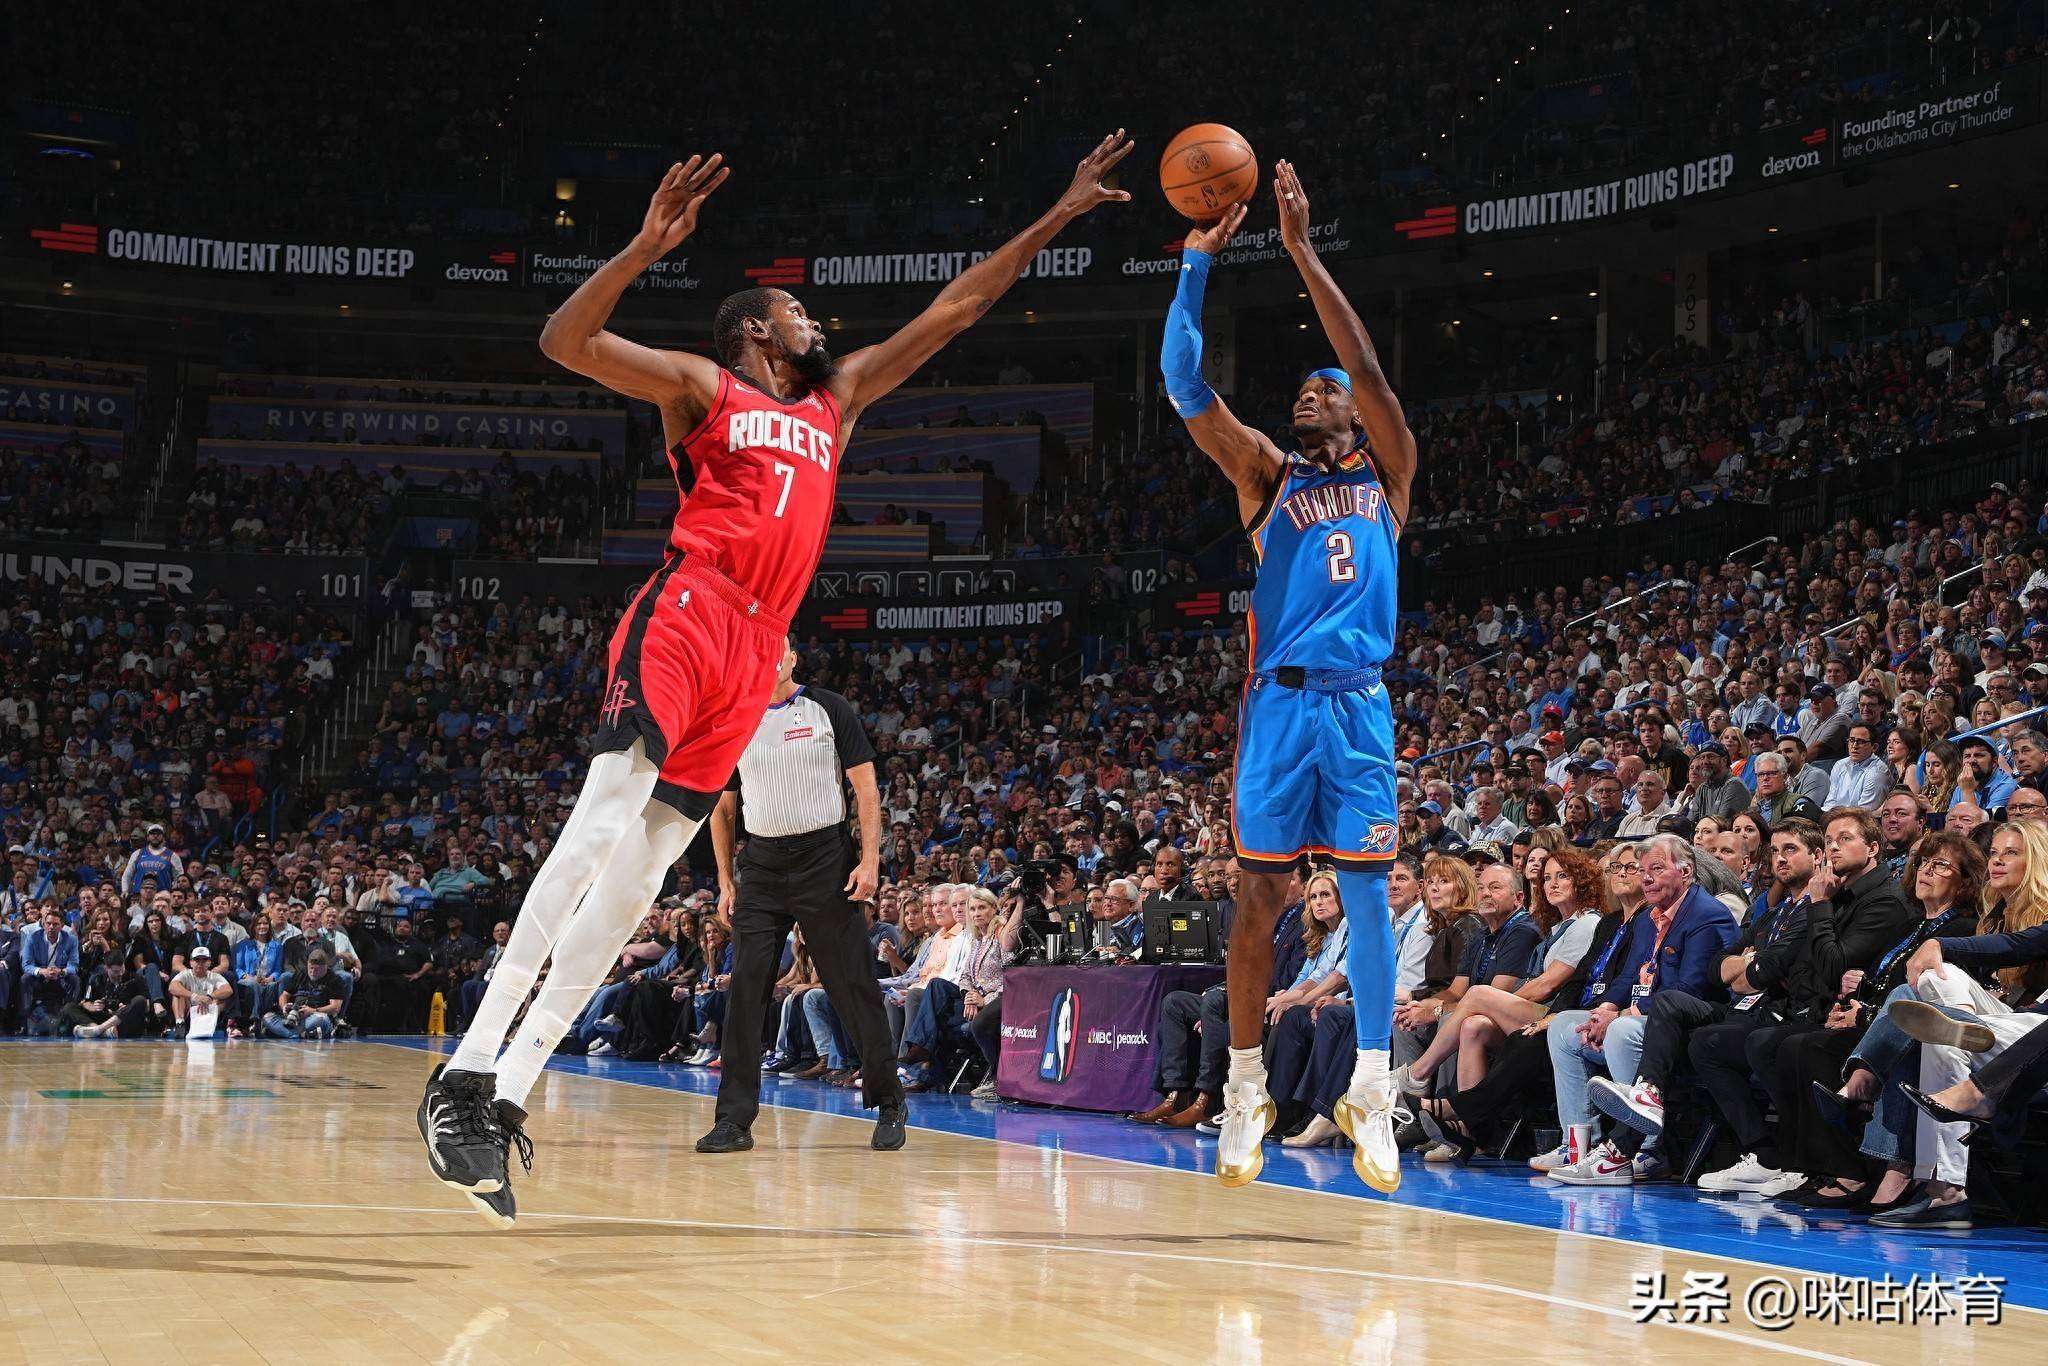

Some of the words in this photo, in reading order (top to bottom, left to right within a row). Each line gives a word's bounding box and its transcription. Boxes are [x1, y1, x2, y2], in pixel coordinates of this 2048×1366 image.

[1842, 110, 1917, 140] Founding
[1919, 91, 1981, 121] Partner
[1983, 81, 2002, 102] of
[1842, 141, 1864, 160] the
[1864, 127, 1929, 153] Oklahoma
[1931, 118, 1957, 140] City
[1959, 103, 2016, 131] Thunder
[1761, 149, 1821, 178] devon
[1465, 179, 1621, 234] COMMITMENT
[1624, 166, 1679, 211] RUNS
[1682, 152, 1735, 197] DEEP
[1324, 217, 1340, 235] of
[106, 228, 282, 273] COMMITMENT
[285, 244, 351, 275] RUNS
[356, 247, 416, 279] DEEP
[672, 257, 689, 273] of
[813, 251, 967, 286] COMMITMENT
[1036, 247, 1093, 279] DEEP
[1121, 256, 1180, 275] devon
[1220, 244, 1276, 265] Oklahoma
[445, 262, 510, 282] devon
[533, 271, 553, 284] the
[650, 276, 701, 289] Thunder
[267, 407, 441, 433] RIVERWIND
[455, 416, 570, 437] CASINO
[728, 409, 833, 473] ROCKETS
[773, 461, 796, 518] 7
[1280, 482, 1382, 533] THUNDER
[1325, 530, 1357, 585] 2
[0, 552, 194, 595] UNDER
[321, 573, 362, 598] 101
[458, 575, 501, 602] 102
[876, 604, 983, 630] COMMITMENT
[985, 602, 1024, 627] RUNS
[1094, 1031, 1112, 1045] NBC
[1116, 1030, 1149, 1050] peacock
